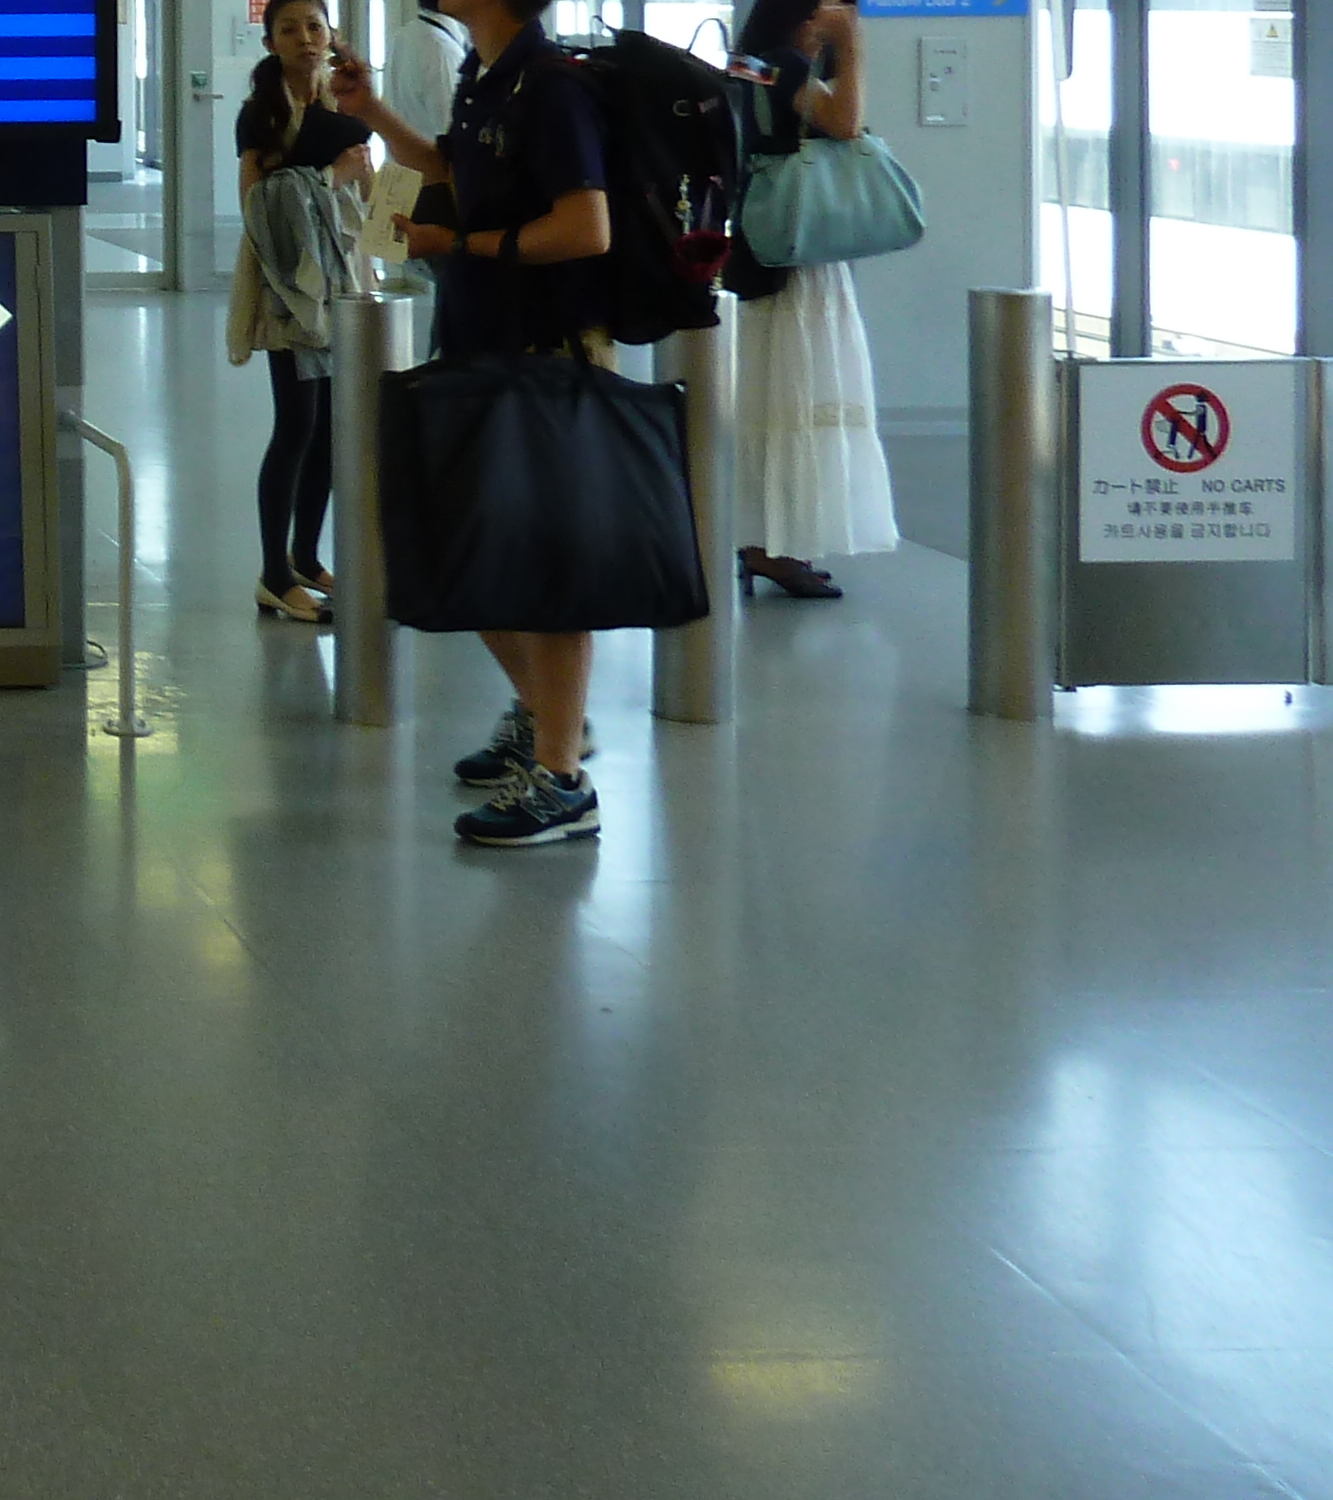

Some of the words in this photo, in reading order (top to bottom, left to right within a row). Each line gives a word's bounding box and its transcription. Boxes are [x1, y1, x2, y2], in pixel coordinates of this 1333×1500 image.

[1092, 478, 1179, 495] カート禁止
[1201, 479, 1226, 493] NO
[1230, 479, 1286, 493] CARTS
